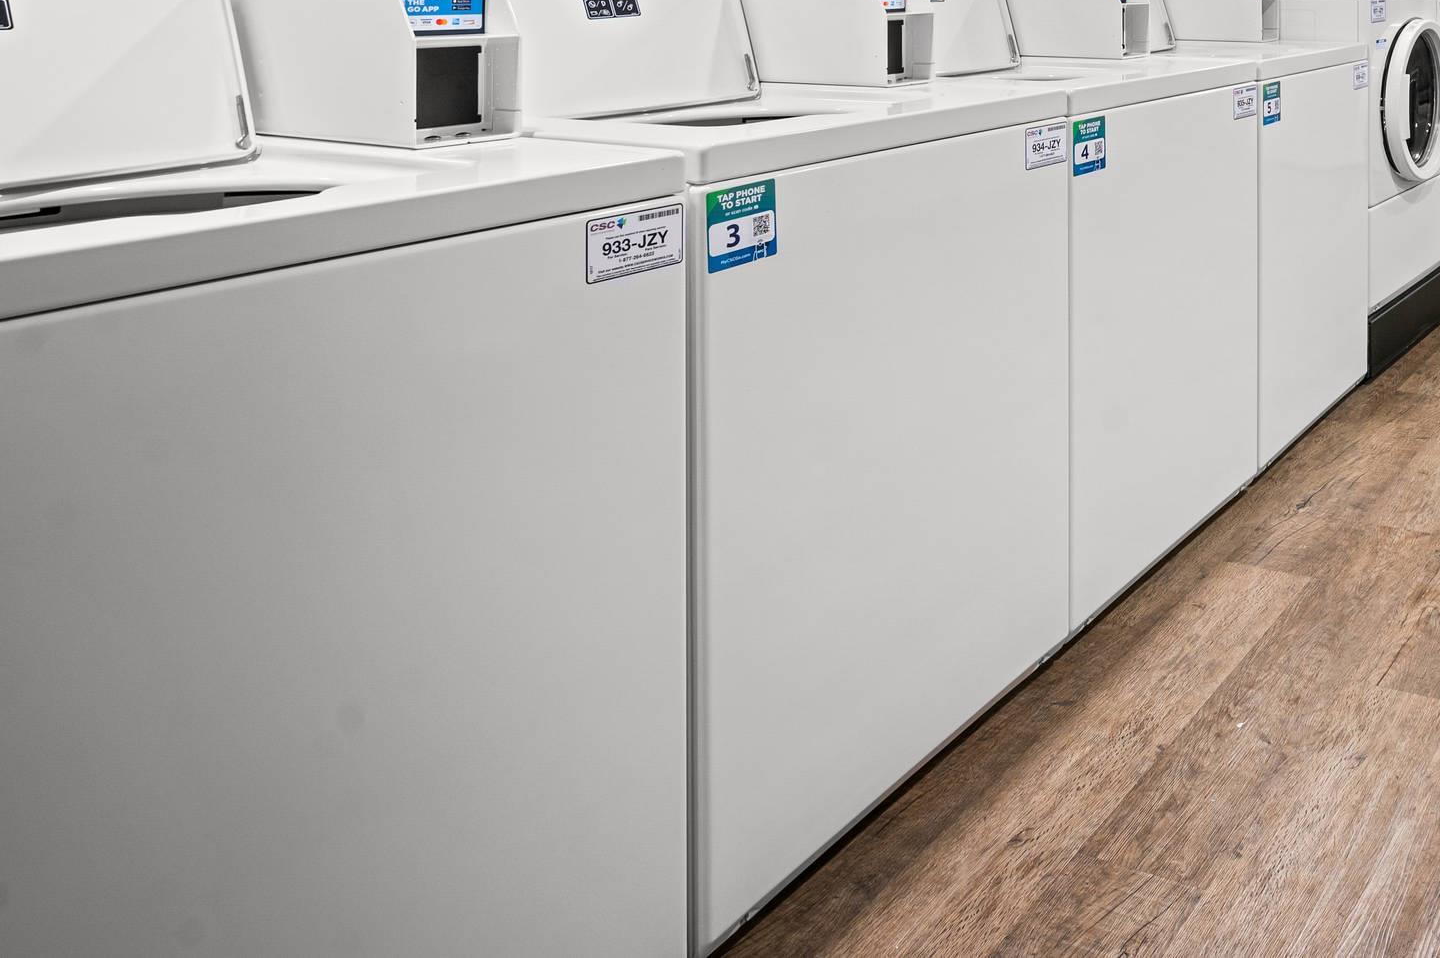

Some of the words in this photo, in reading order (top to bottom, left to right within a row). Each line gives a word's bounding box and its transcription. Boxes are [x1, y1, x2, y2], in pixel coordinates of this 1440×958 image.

[1266, 102, 1272, 114] 5
[1086, 126, 1100, 134] START
[1032, 139, 1061, 153] 934-JZY
[1081, 144, 1089, 160] 4
[717, 192, 735, 203] TAP
[736, 185, 766, 199] PHONE
[721, 201, 734, 211] TO
[735, 194, 762, 207] START
[590, 221, 616, 232] CSC
[602, 229, 669, 256] 933-JZY
[726, 223, 741, 248] 3
